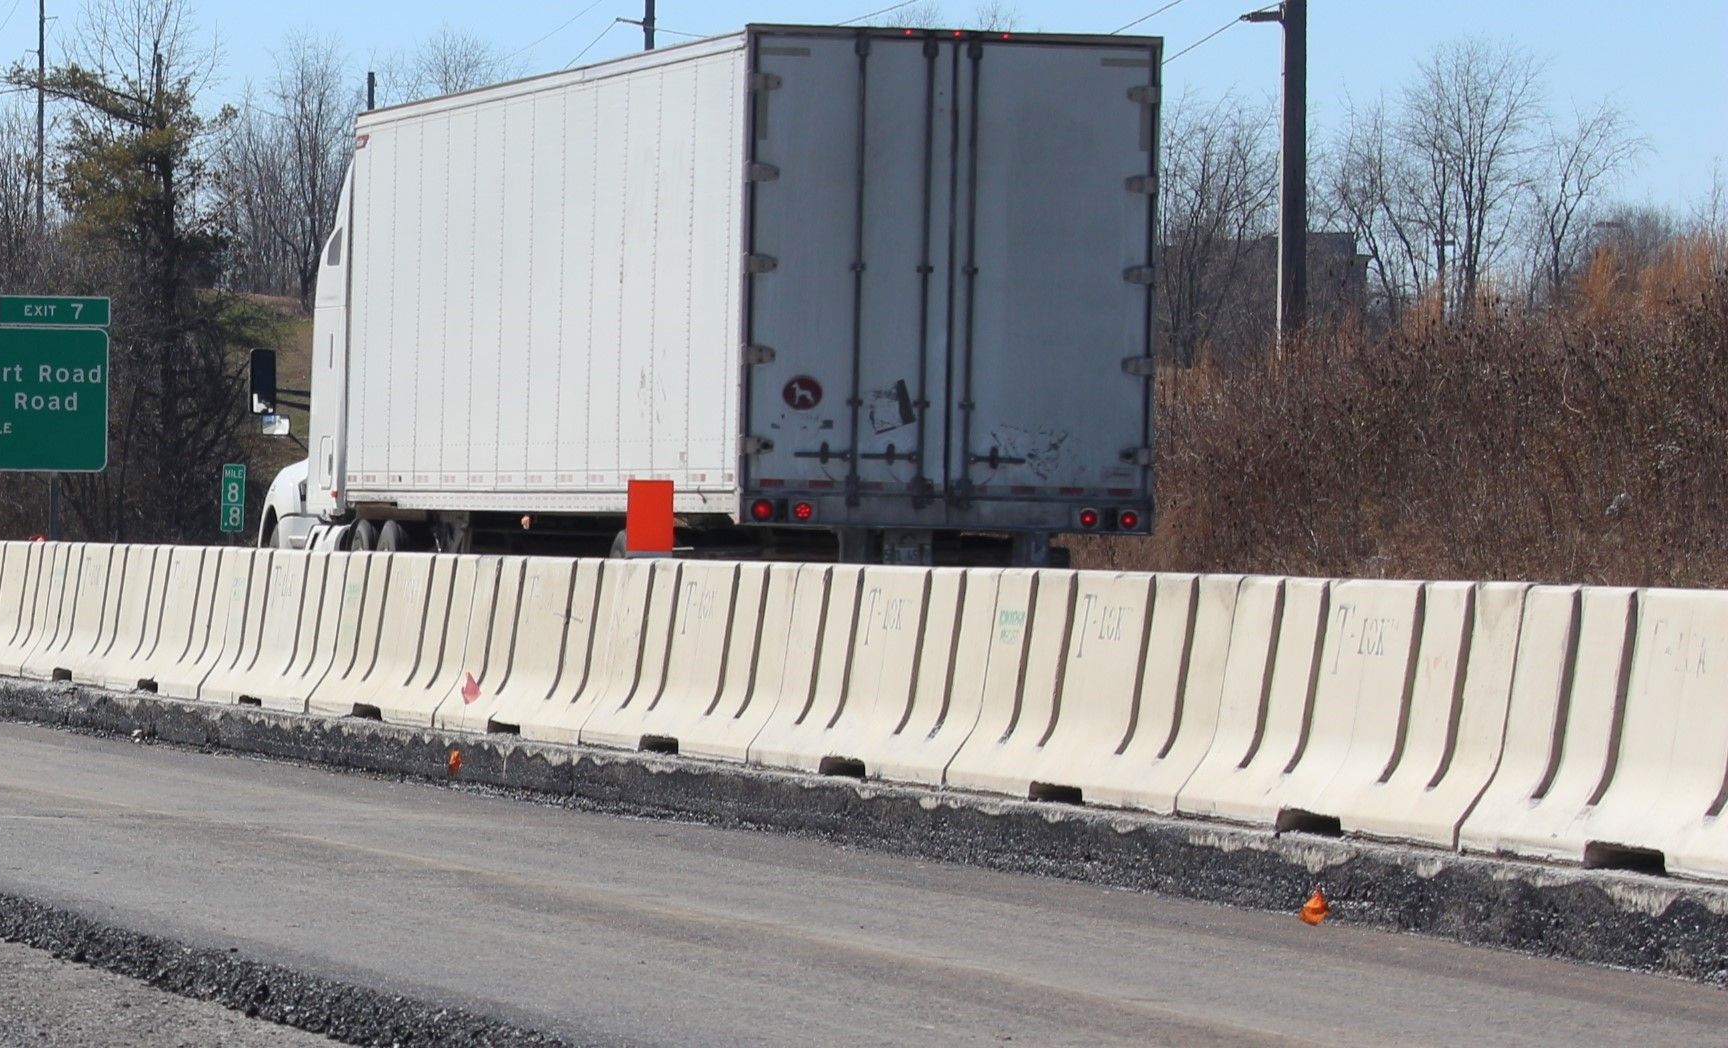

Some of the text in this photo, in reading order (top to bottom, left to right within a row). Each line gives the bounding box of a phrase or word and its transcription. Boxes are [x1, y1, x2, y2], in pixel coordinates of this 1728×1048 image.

[24, 303, 84, 320] EXIT 7
[38, 364, 102, 384] Road
[14, 392, 78, 411] Road
[224, 469, 243, 479] MILE
[227, 482, 239, 503] 8
